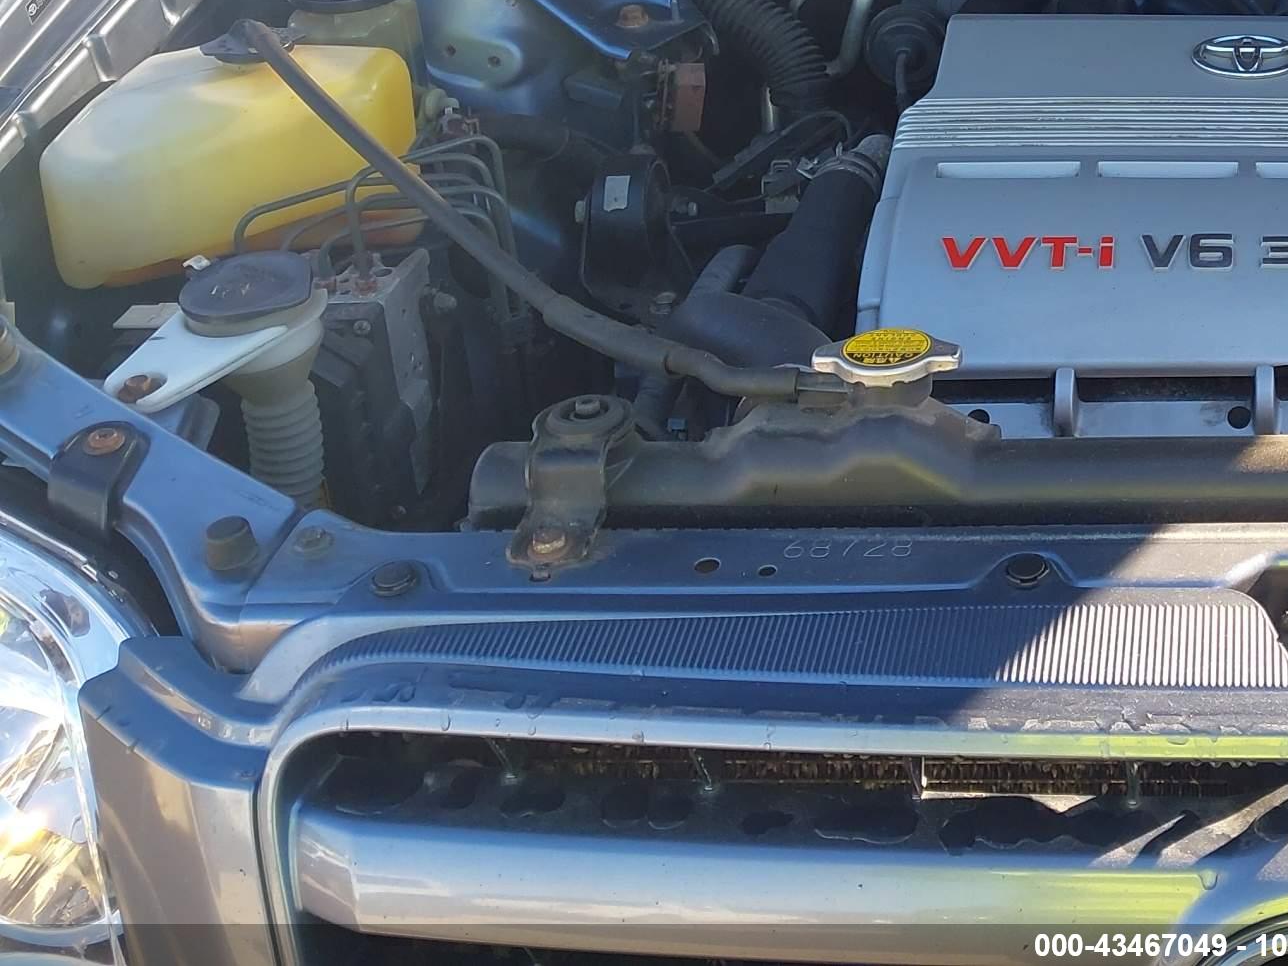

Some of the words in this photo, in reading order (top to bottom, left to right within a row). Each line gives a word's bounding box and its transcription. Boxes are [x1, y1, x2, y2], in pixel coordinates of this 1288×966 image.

[940, 235, 1118, 271] VVT-i
[1140, 233, 1236, 271] V6
[783, 537, 913, 559] 68728
